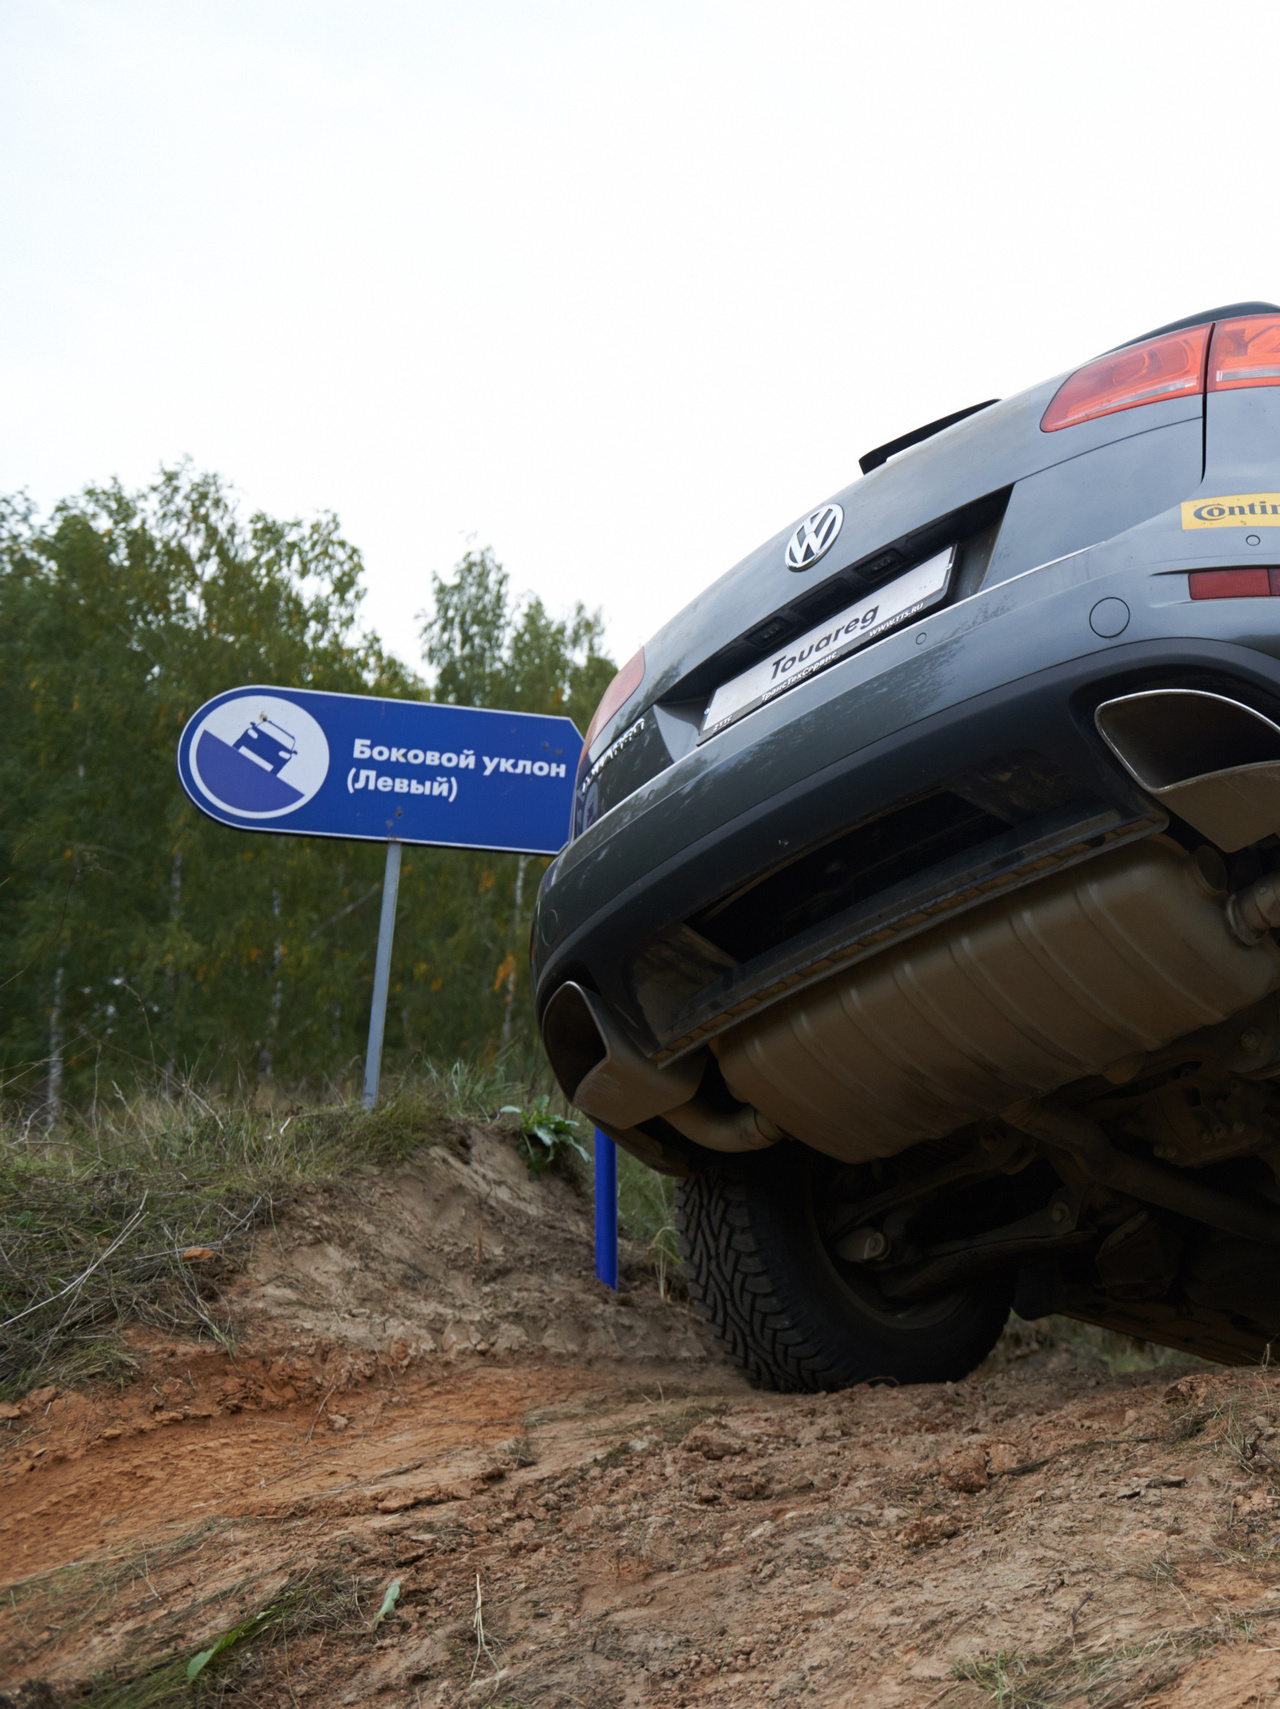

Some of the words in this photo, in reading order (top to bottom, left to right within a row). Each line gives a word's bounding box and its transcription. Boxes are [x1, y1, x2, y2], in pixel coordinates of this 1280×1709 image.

[771, 605, 879, 680] Touareg
[353, 738, 476, 770] Боковой
[482, 756, 567, 778] уклон
[347, 767, 458, 803] (Левый)
